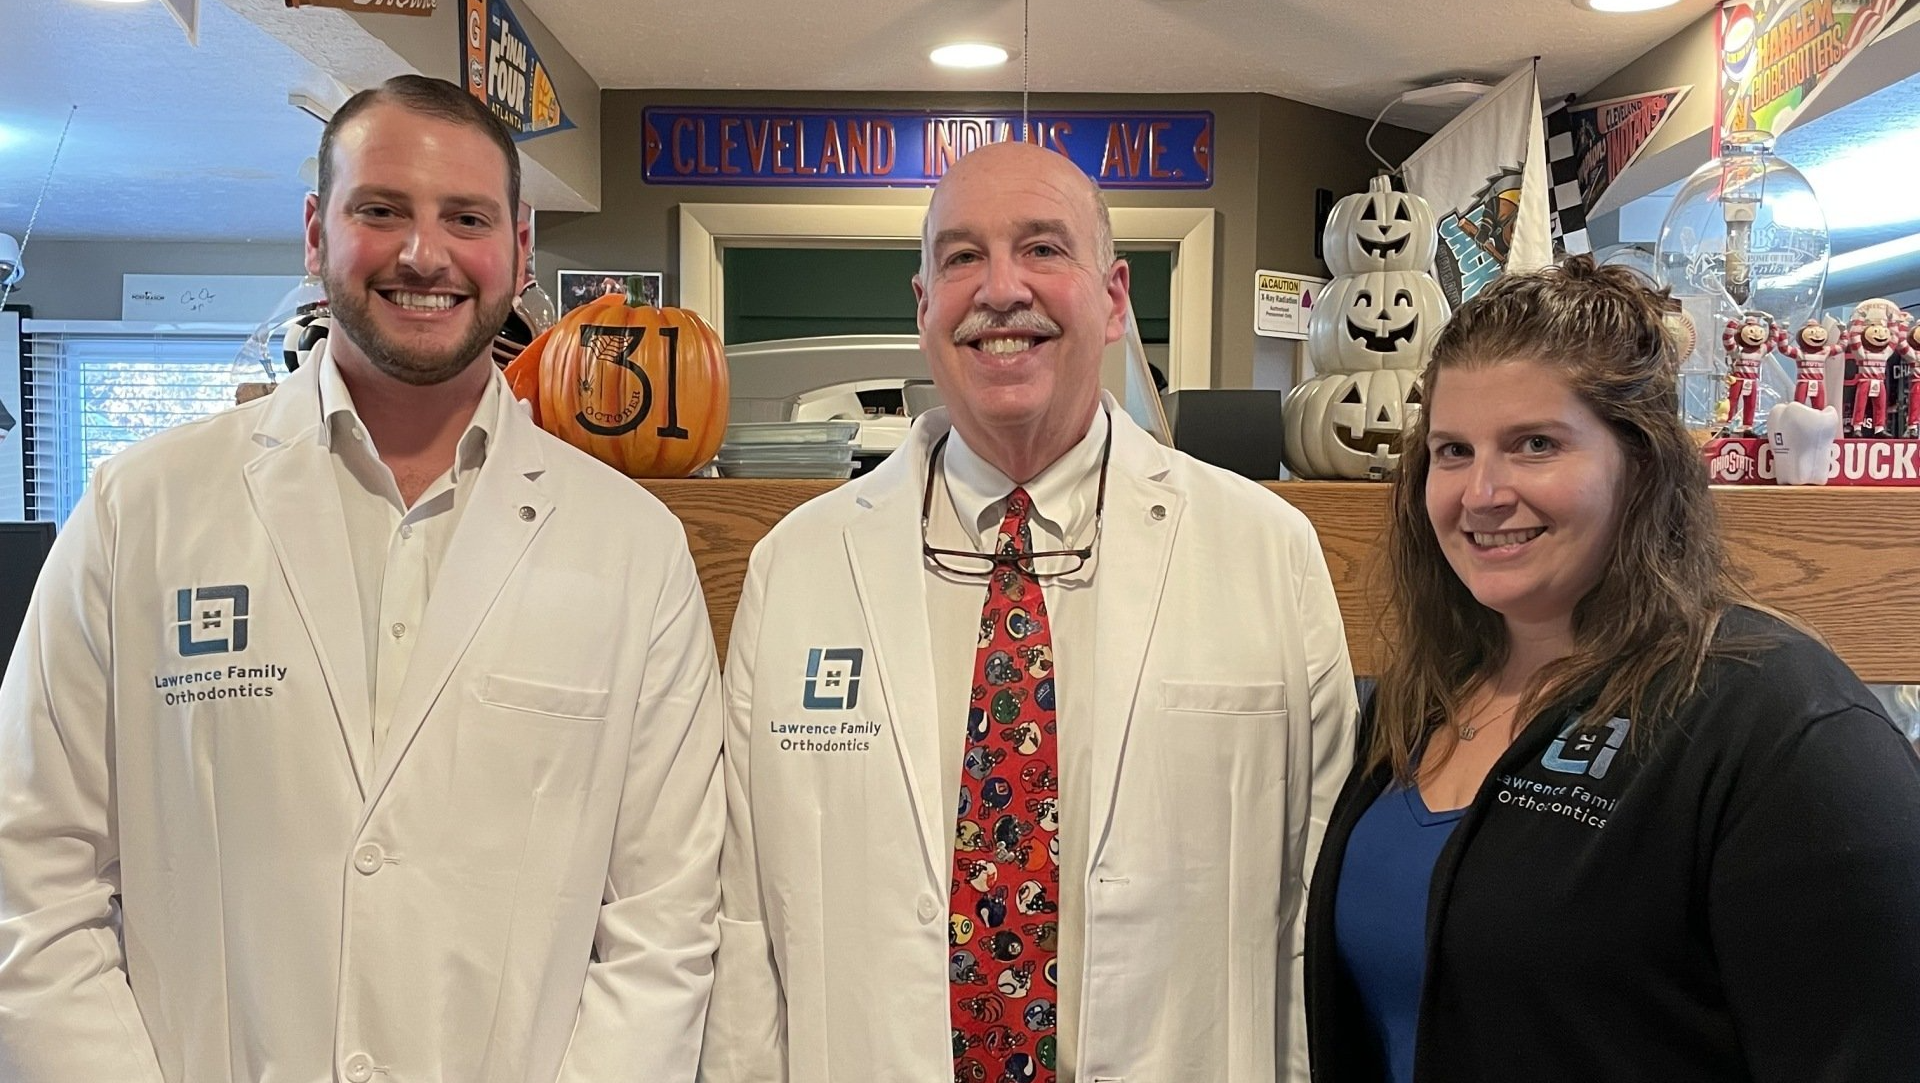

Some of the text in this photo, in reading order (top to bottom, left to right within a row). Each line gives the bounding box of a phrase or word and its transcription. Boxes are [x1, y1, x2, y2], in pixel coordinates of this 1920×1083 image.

[501, 19, 527, 72] FINAL
[1756, 0, 1834, 71] HARLEM
[488, 38, 526, 115] FOUR
[1751, 22, 1842, 112] GLOBETROTTERS
[491, 102, 522, 130] ATLANTA
[1606, 101, 1642, 131] CLEVELAND
[672, 117, 896, 177] CLEVELAND
[1100, 121, 1183, 178] AVE.
[1607, 96, 1667, 184] INDIANS
[1268, 279, 1298, 291] CAUTION
[1276, 295, 1298, 304] Radiation
[576, 325, 688, 439] 31
[586, 391, 641, 423] OCTOBER
[155, 664, 287, 688] Lawrence Family
[165, 683, 274, 706] Orthodontics
[770, 721, 881, 736] Lawrence Family
[780, 738, 870, 752] Orthodontics
[1571, 786, 1617, 812] Fami
